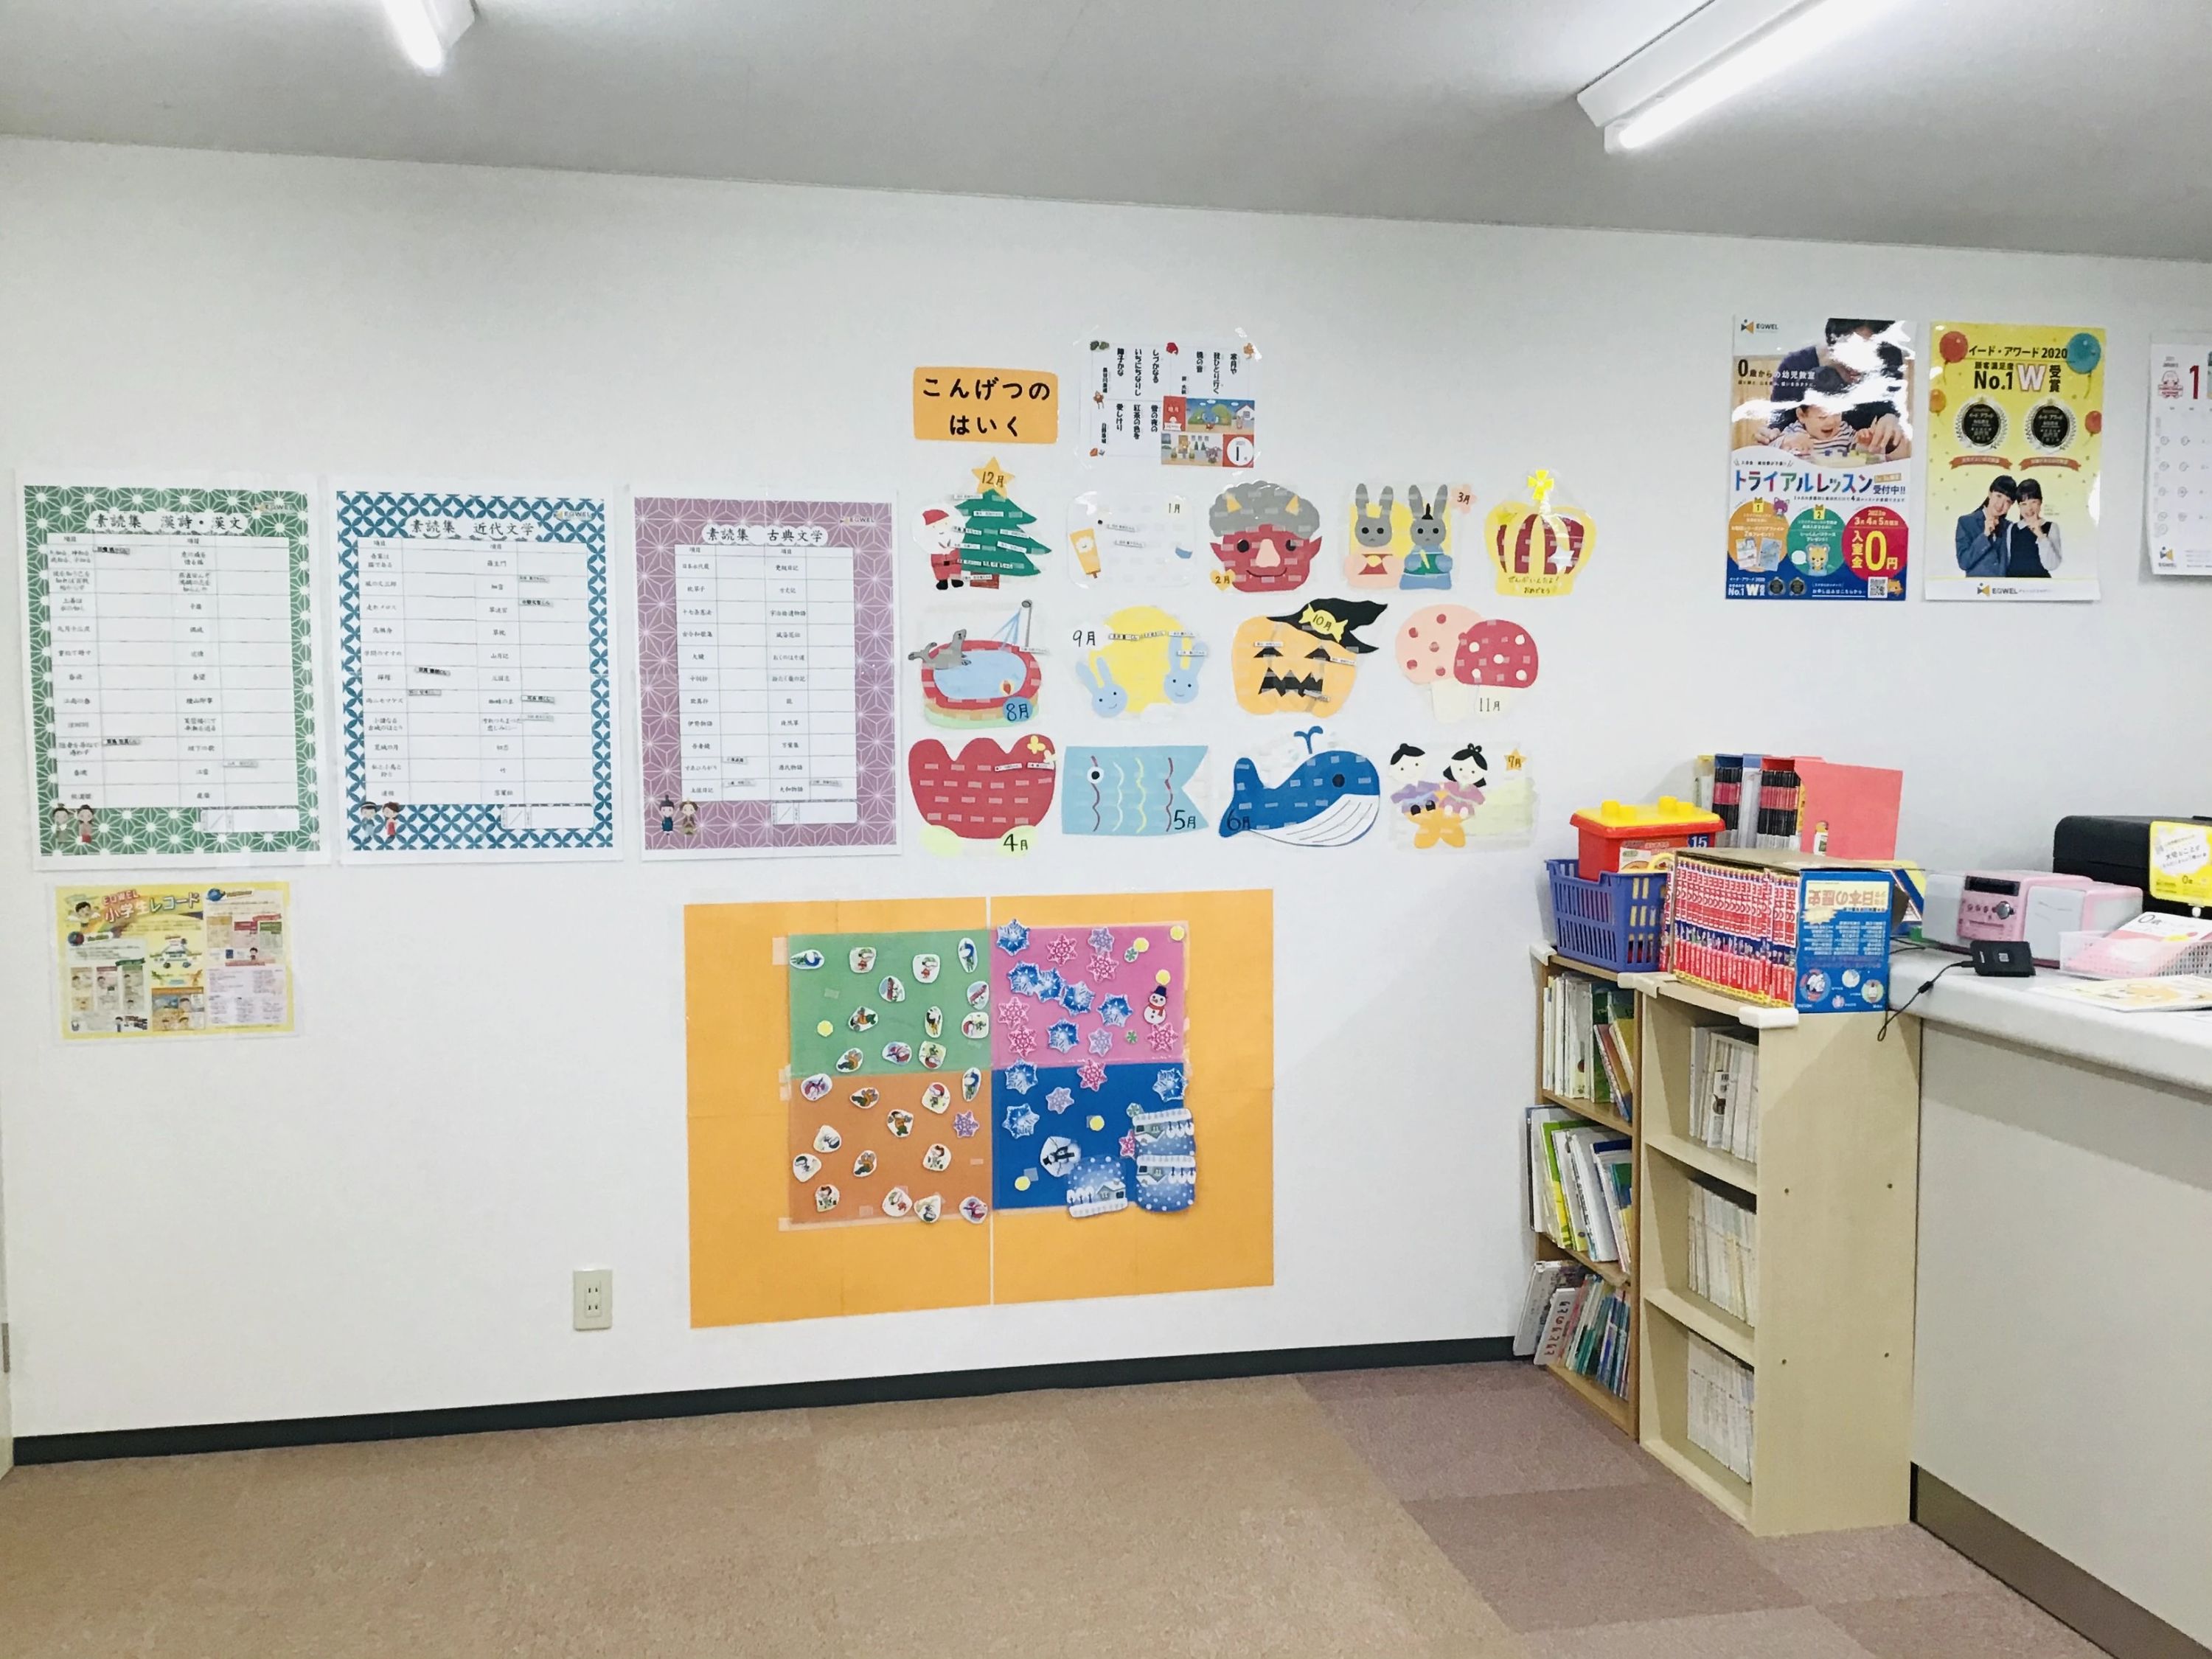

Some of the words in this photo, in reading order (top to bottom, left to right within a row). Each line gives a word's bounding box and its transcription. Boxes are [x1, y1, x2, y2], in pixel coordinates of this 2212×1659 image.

[1969, 345, 2039, 358] イード・アワード
[2042, 347, 2068, 359] 2020
[1738, 359, 1816, 380] 0歳からの幼児教室
[1975, 361, 2014, 370] 顧客満足度
[1974, 371, 2013, 390] No.1
[2017, 364, 2046, 392] W
[2049, 365, 2062, 392] 受賞
[2190, 365, 2199, 400] 1
[922, 376, 1051, 402] こんげつの
[950, 414, 1019, 437] はいく
[982, 470, 1004, 488] 12月
[1735, 470, 1873, 493] トライアルレッスン
[1456, 492, 1470, 504] 3月
[1169, 503, 1180, 514] 1月
[1817, 511, 1821, 519] 2
[94, 514, 142, 529] 素読集
[160, 515, 243, 530] 漢詩・漢文
[410, 519, 456, 534] 素読集
[473, 521, 535, 536] 近代文学
[706, 527, 749, 542] 素読集
[767, 529, 824, 543] 古典文学
[1851, 530, 1863, 568] 入室金
[1865, 530, 1898, 571] 0円
[1215, 575, 1231, 585] 2月
[1746, 584, 1759, 596] W
[1312, 613, 1332, 631] 10月
[1072, 630, 1096, 647] 9月
[1006, 703, 1029, 722] 8月
[1479, 698, 1501, 712] 11月
[1508, 755, 1522, 768] 7月
[1174, 810, 1196, 830] 5月
[1226, 809, 1251, 832] 6月
[1004, 834, 1028, 853] 4月
[1691, 835, 1708, 848] 15
[105, 891, 201, 923] 小学生レコード
[1807, 889, 1874, 907] 日本の歴史
